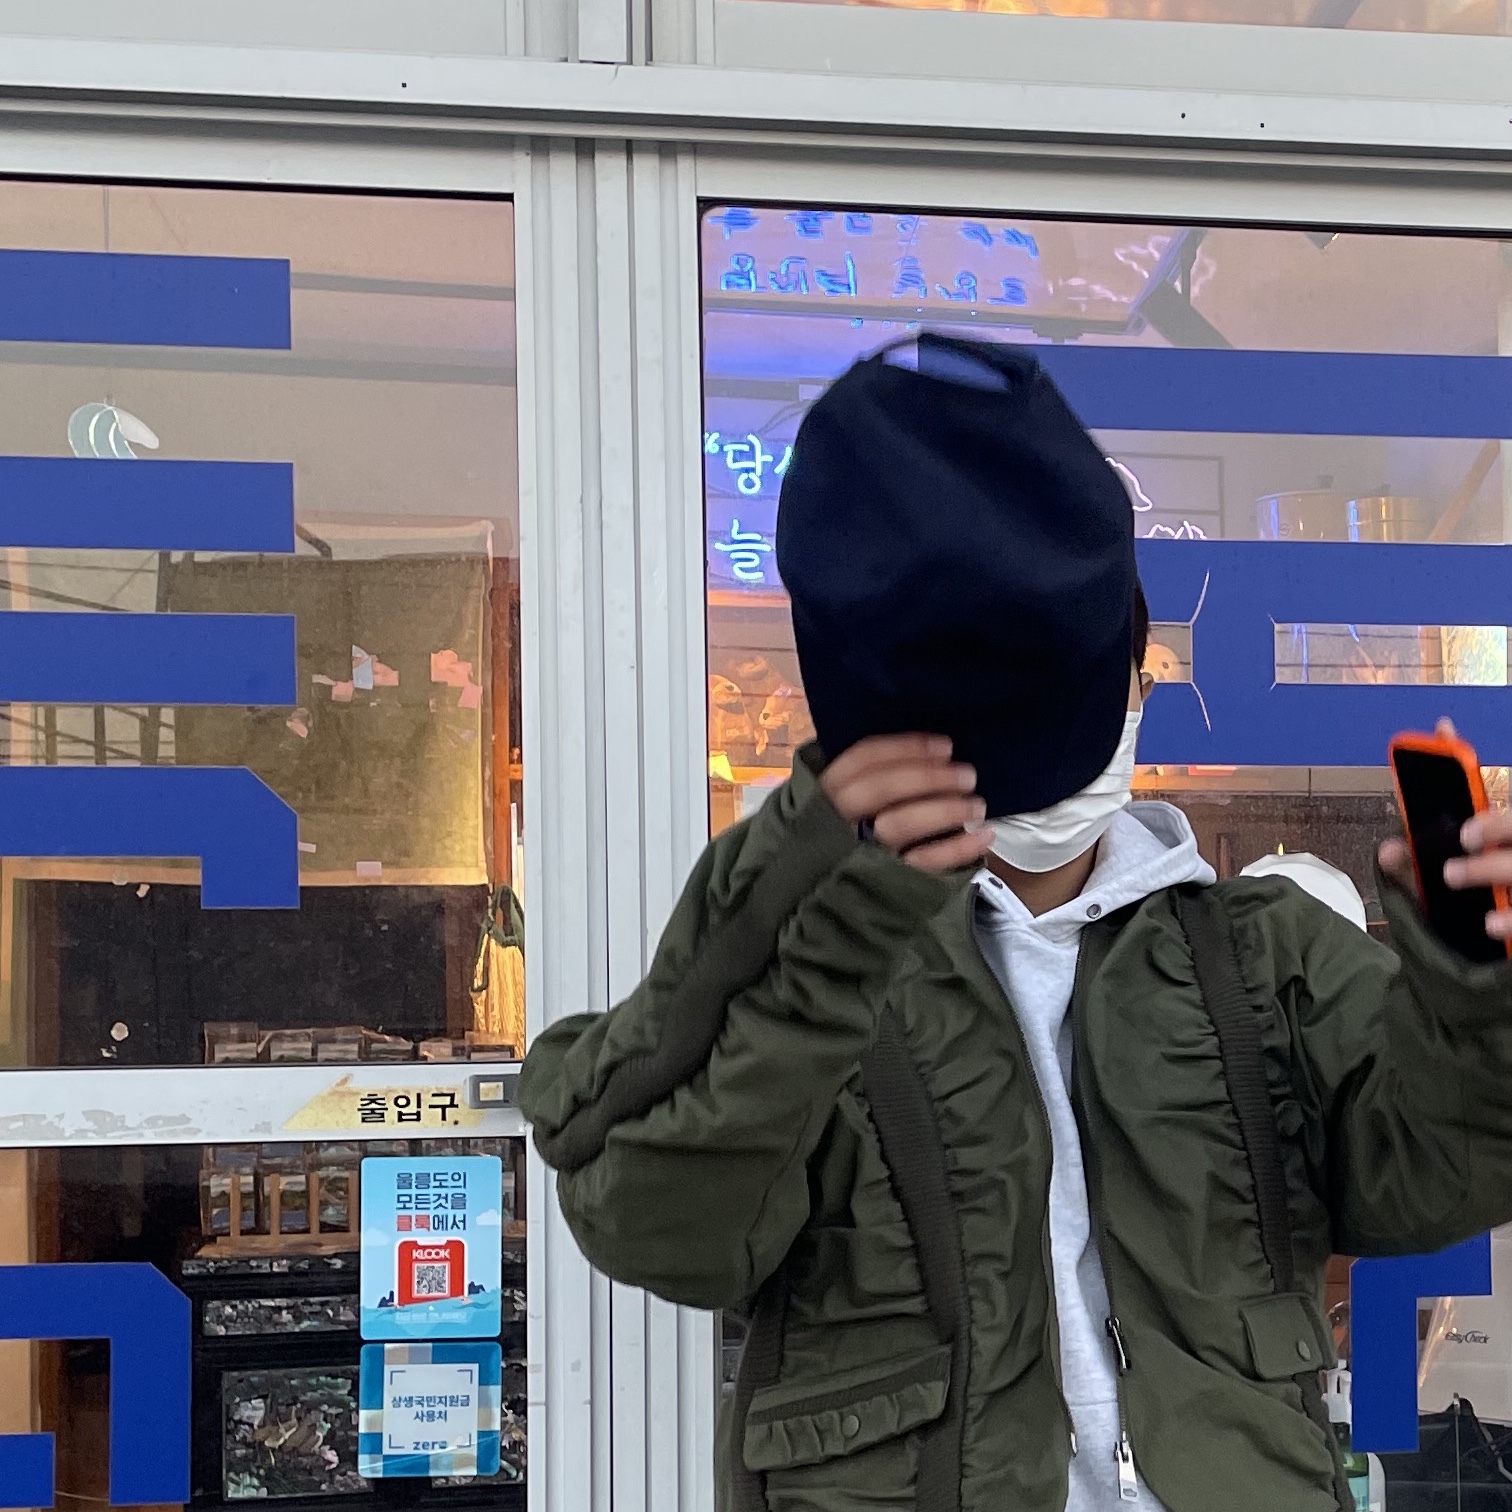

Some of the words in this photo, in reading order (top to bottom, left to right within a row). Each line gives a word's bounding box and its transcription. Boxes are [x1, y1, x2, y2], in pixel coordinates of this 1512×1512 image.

[713, 518, 774, 585] 늘
[356, 1092, 460, 1124] 출입구
[396, 1171, 467, 1190] 울릉도의
[395, 1193, 467, 1211] 모든것을
[396, 1213, 467, 1232] 클룩에서
[412, 1248, 451, 1260] KLOOK
[391, 1394, 470, 1408] 상생국민지원금
[413, 1410, 448, 1423] 사용처
